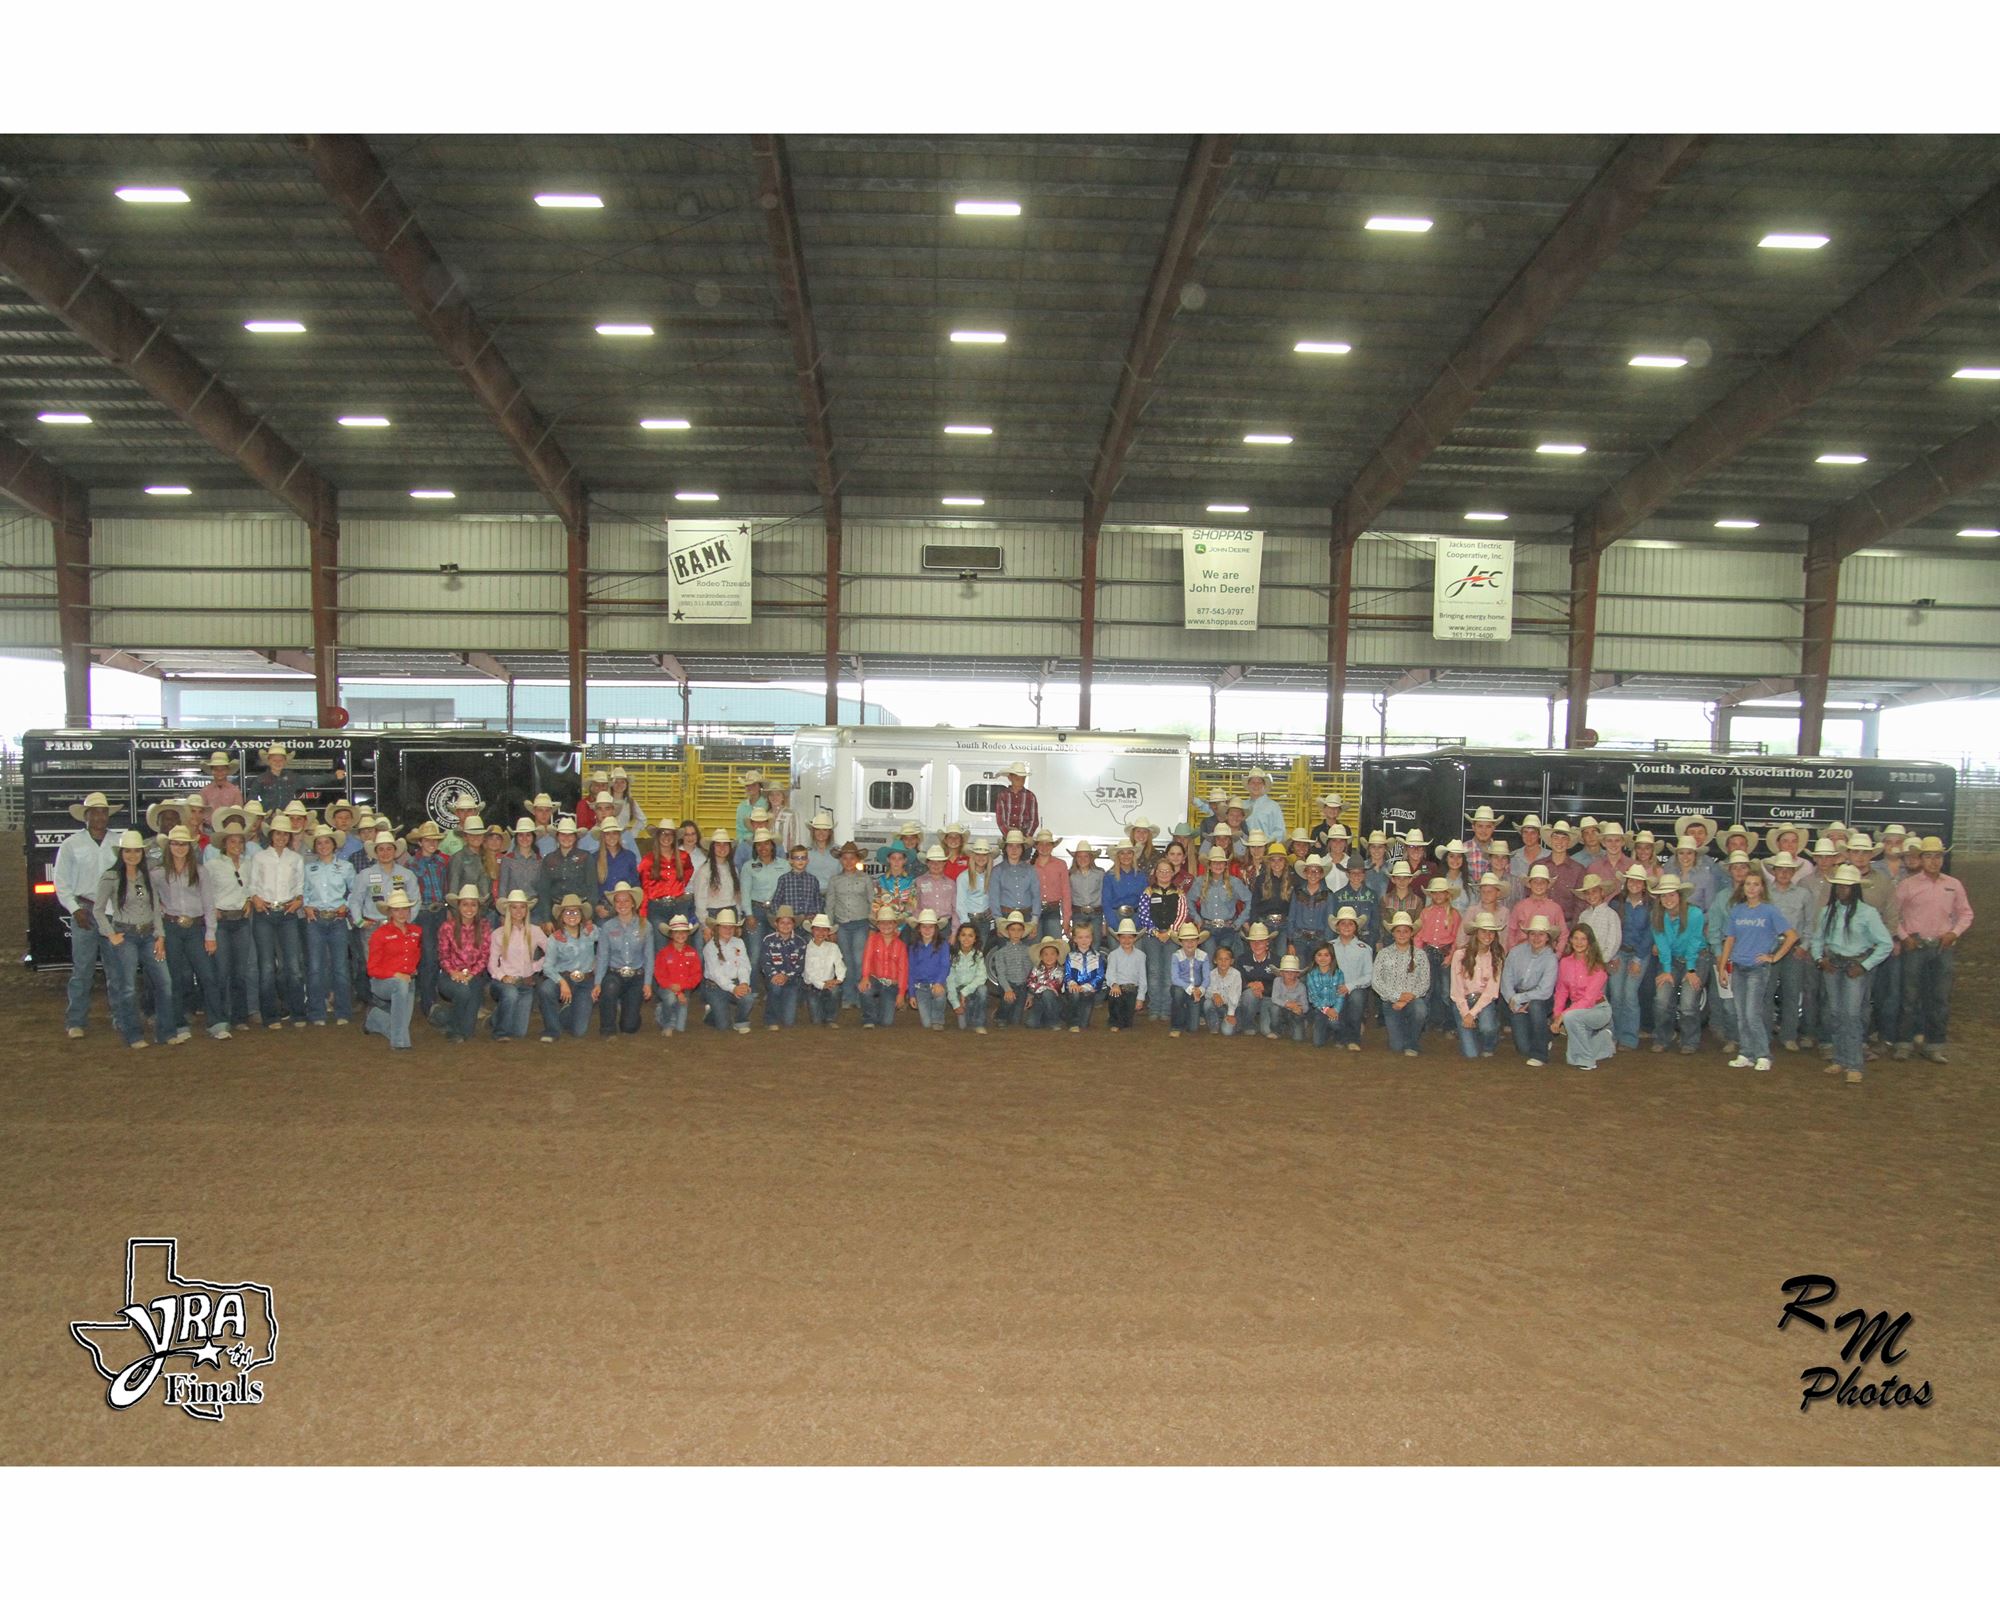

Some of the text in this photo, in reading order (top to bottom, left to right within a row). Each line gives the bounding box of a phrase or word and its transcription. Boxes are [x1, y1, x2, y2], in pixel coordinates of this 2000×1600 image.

[1192, 529, 1254, 541] SHOPPA'S
[675, 540, 731, 578] RANK
[1446, 551, 1503, 560] Cooperative, Inc.
[1202, 569, 1239, 579] We are
[1445, 565, 1503, 598] JEC
[1189, 583, 1255, 594] John Deere!
[1196, 607, 1244, 616] 877-543-9797
[1439, 612, 1464, 620] Bringing
[1187, 618, 1256, 627] www.shoppas.com
[44, 740, 93, 751] PRIMO
[130, 738, 175, 749] Youth
[180, 738, 227, 749] Rodeo
[317, 739, 351, 749] 2020
[956, 741, 979, 750] Youth
[982, 741, 1007, 750] Rodeo
[1009, 743, 1053, 752] Association
[1632, 763, 1853, 779] Youth Rodeo Association 2020
[158, 778, 212, 788] All-Aroun
[1889, 772, 1936, 783] PRIMO
[429, 781, 447, 803] COUNTY
[1096, 787, 1138, 799] STAR
[1390, 808, 1416, 819] TITAN
[1653, 804, 1713, 815] All-Around
[1769, 807, 1816, 819] Cowgirl
